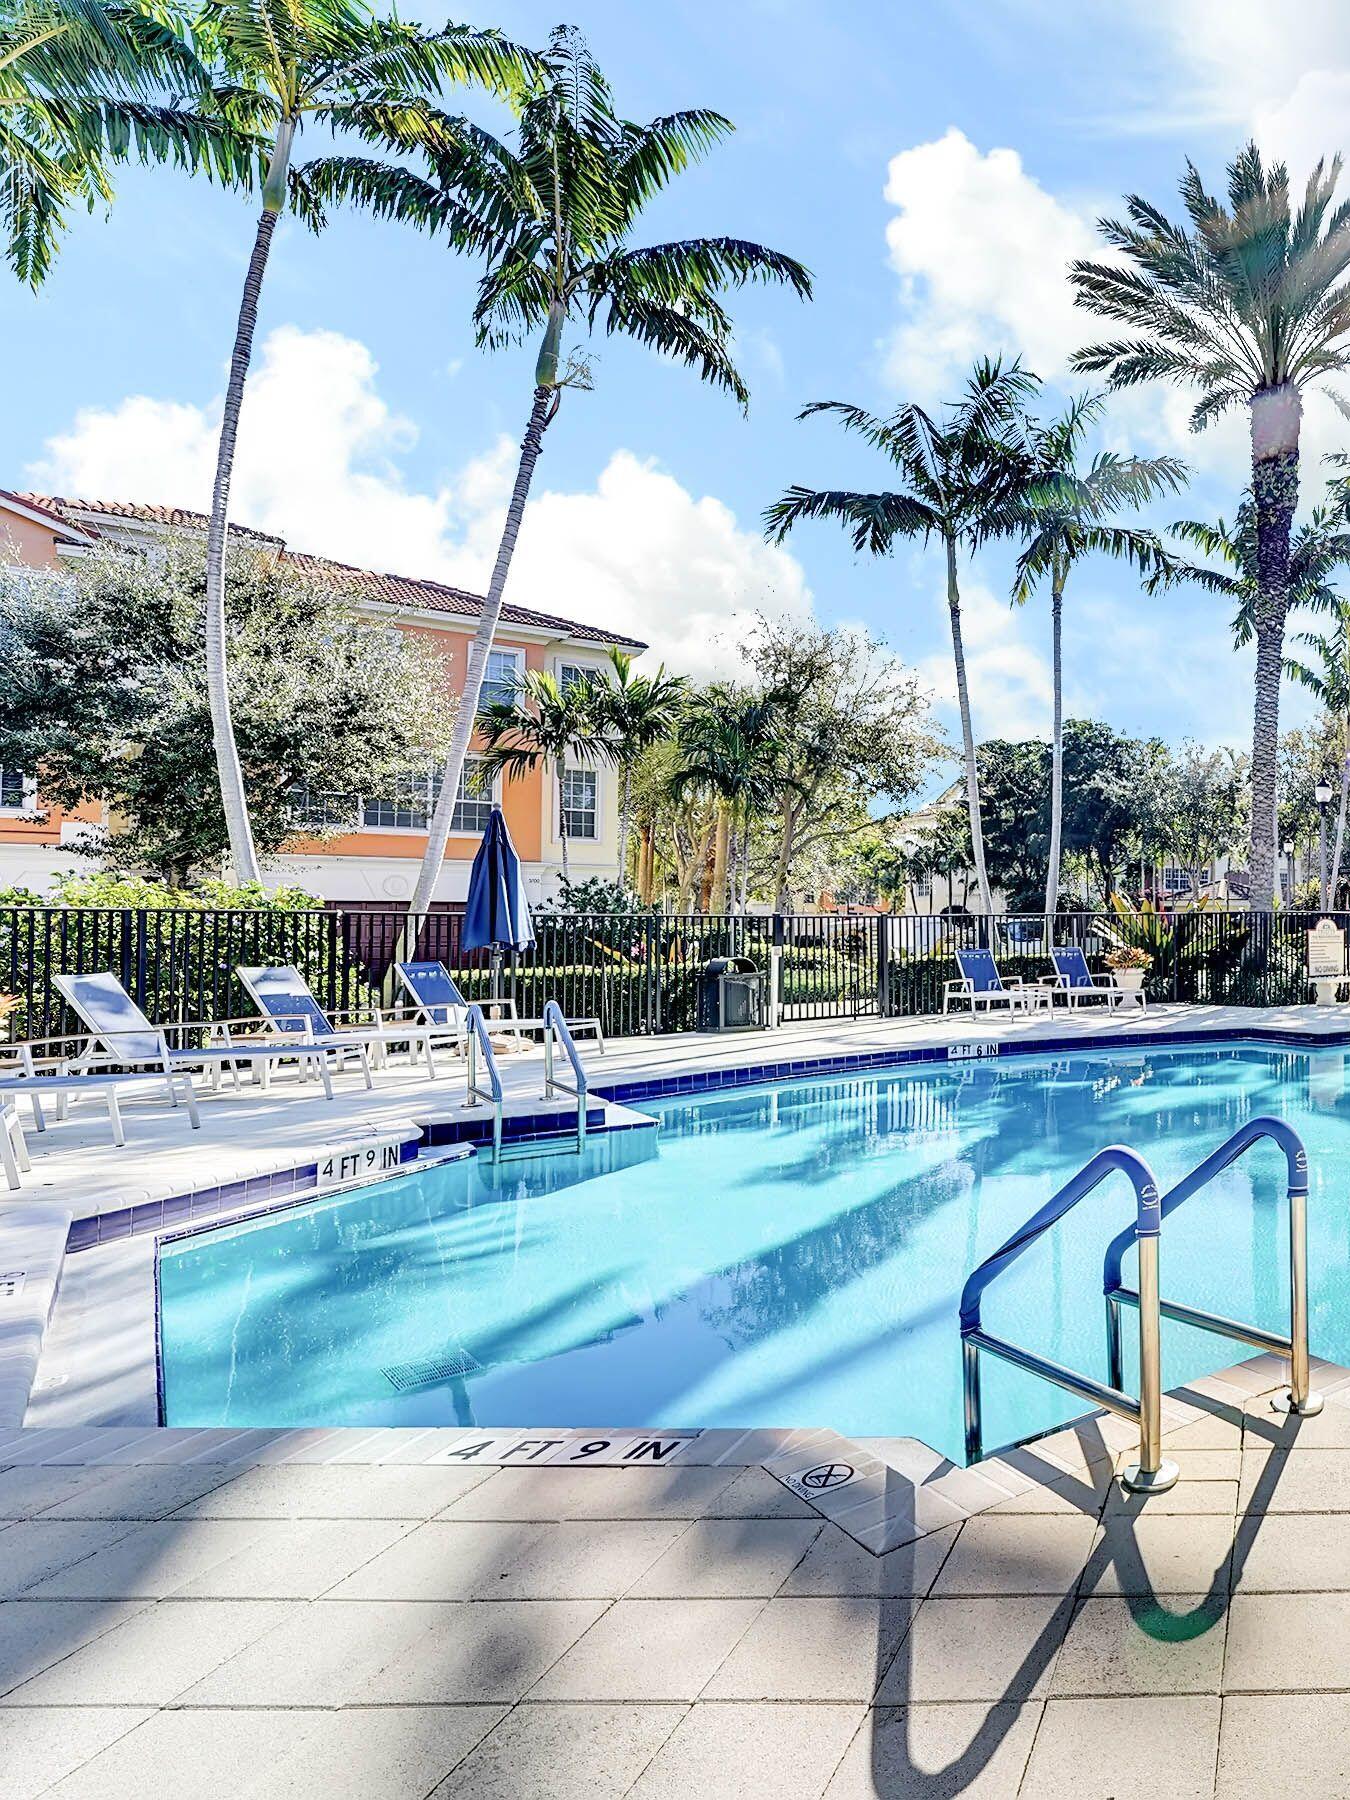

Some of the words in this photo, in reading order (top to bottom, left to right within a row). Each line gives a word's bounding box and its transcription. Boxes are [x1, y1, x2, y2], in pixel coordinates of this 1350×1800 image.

[950, 1046, 957, 1054] 4
[962, 1045, 971, 1054] FT
[976, 1045, 983, 1056] 6
[986, 1044, 997, 1054] IN
[322, 1159, 334, 1177] 4
[340, 1153, 360, 1179] FT
[366, 1150, 375, 1167] 9
[383, 1145, 399, 1169] IN
[447, 1440, 495, 1461] 4
[499, 1440, 564, 1460] FT
[569, 1440, 611, 1461] 9
[623, 1441, 681, 1460] IN
[780, 1474, 796, 1484] NO
[791, 1482, 815, 1499] DIVING
